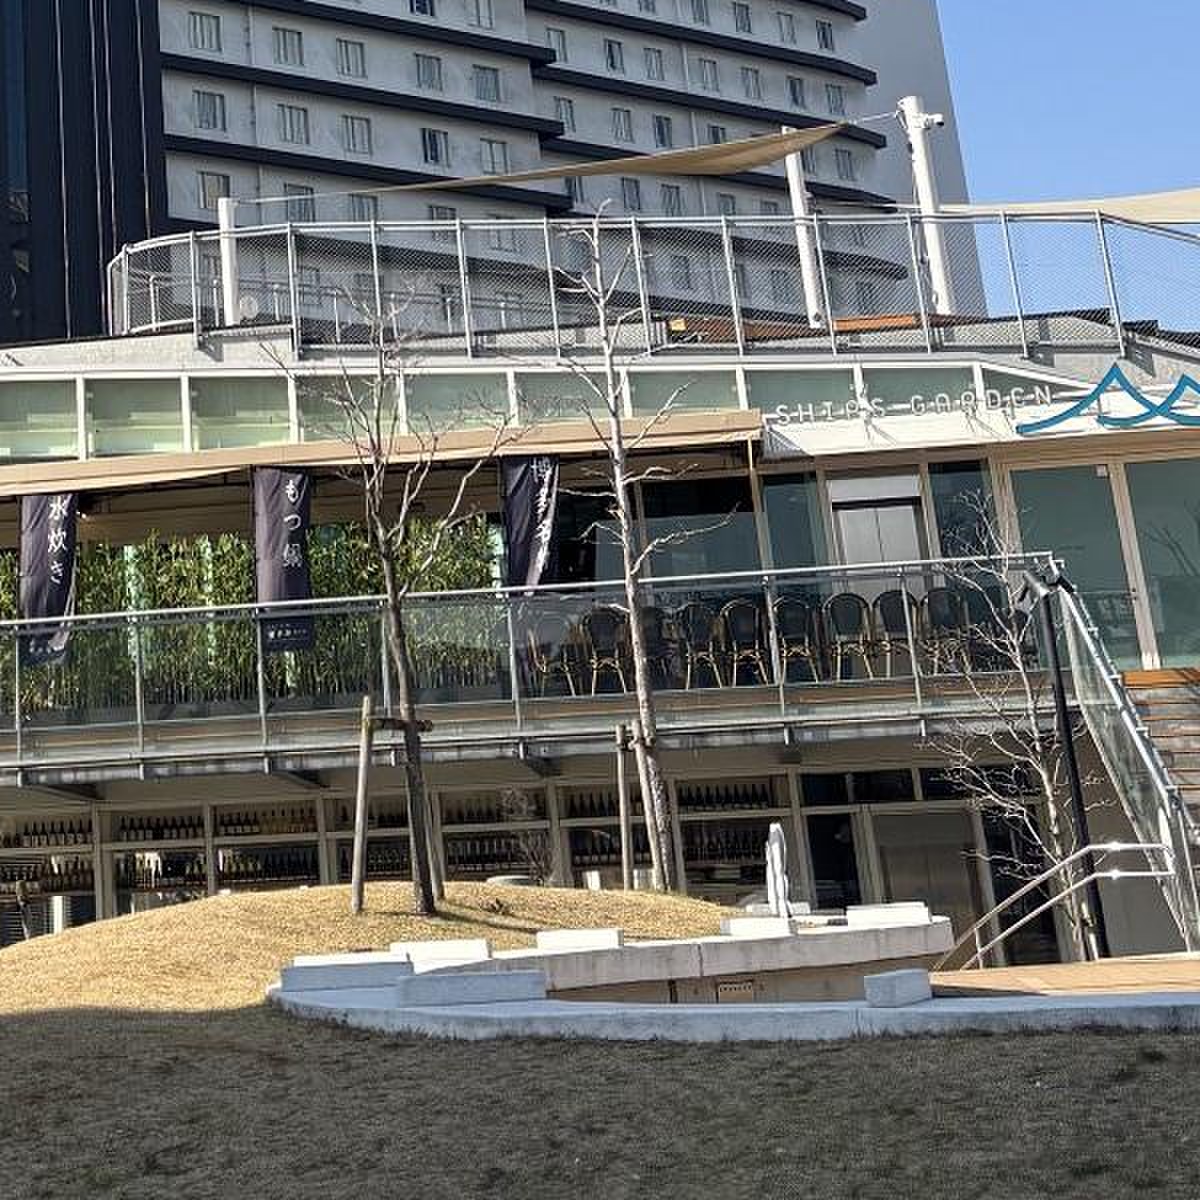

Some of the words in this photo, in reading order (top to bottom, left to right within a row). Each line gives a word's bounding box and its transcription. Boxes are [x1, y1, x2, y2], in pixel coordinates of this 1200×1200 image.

[911, 385, 1050, 415] GARDEN
[48, 495, 67, 584] 水炊き
[283, 479, 303, 568] もつ鍋
